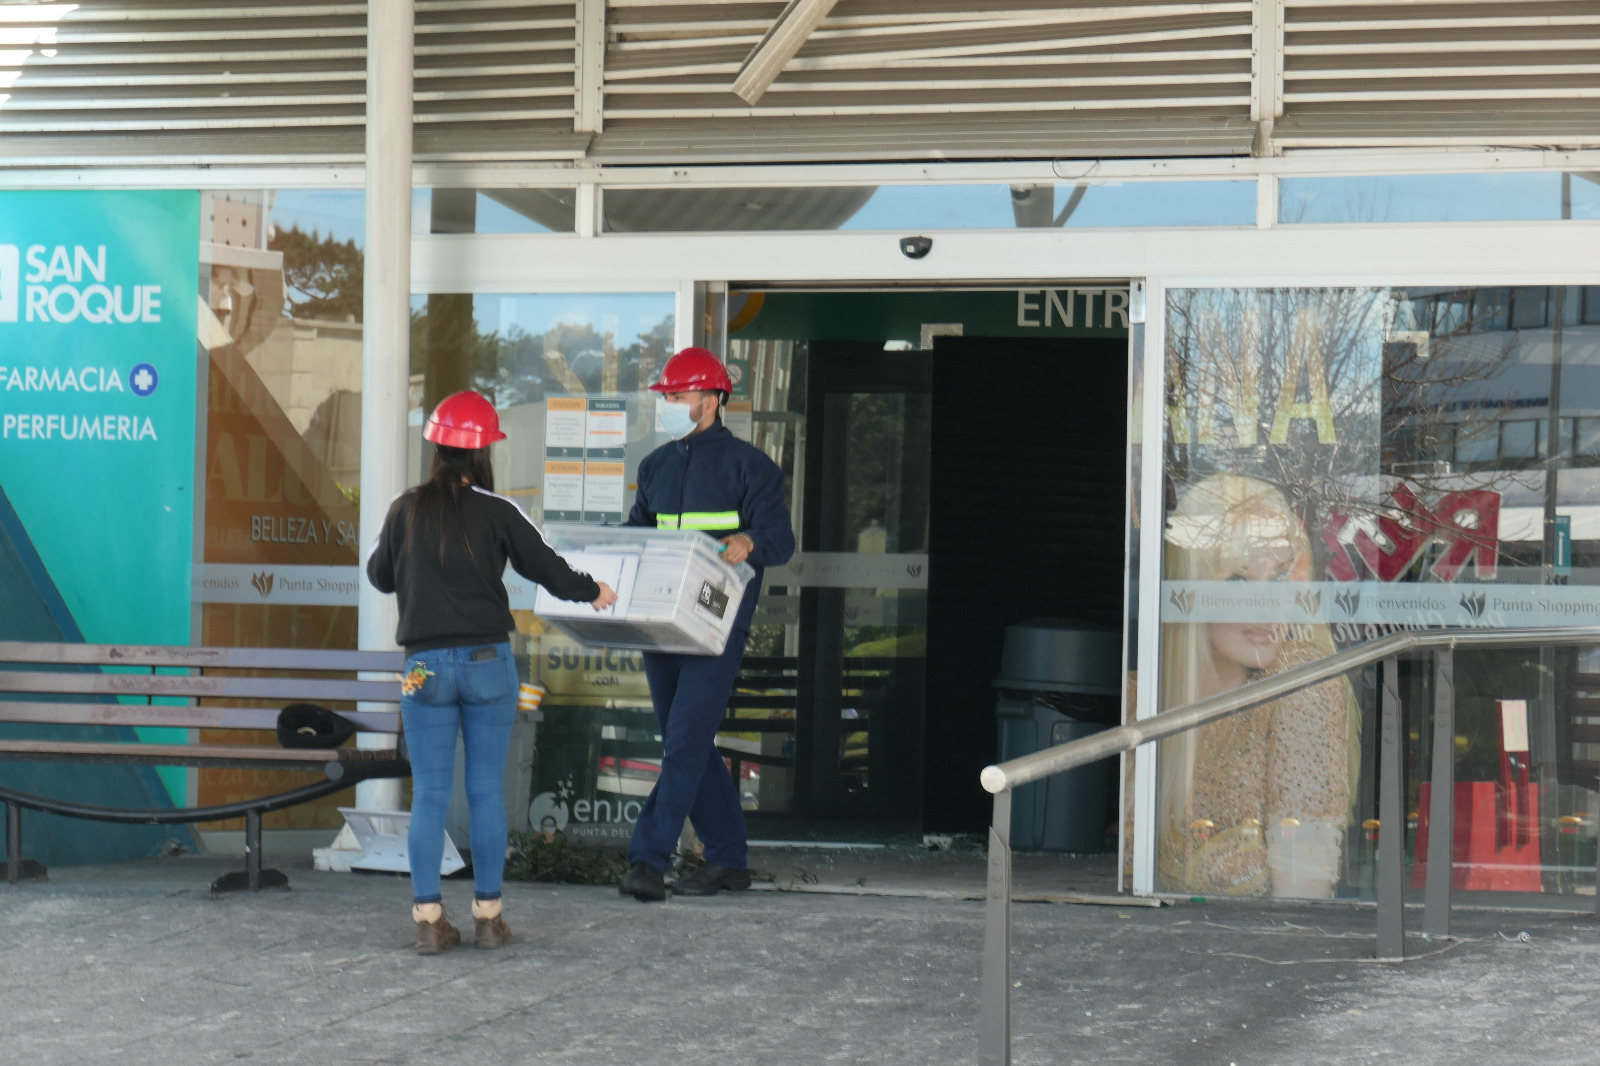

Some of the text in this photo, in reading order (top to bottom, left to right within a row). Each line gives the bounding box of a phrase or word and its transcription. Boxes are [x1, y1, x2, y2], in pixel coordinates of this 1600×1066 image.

[25, 244, 106, 284] SAN
[25, 284, 162, 324] ROQUE
[2, 414, 158, 441] PERFUMERIA
[250, 515, 318, 545] BELLEZA
[320, 519, 333, 545] Y
[279, 577, 313, 592] Punta
[1201, 593, 1282, 609] Bienvenidos
[1366, 595, 1447, 611] Bienvenidos
[1493, 597, 1533, 612] Punta
[572, 826, 633, 839] PUNTA DEL
